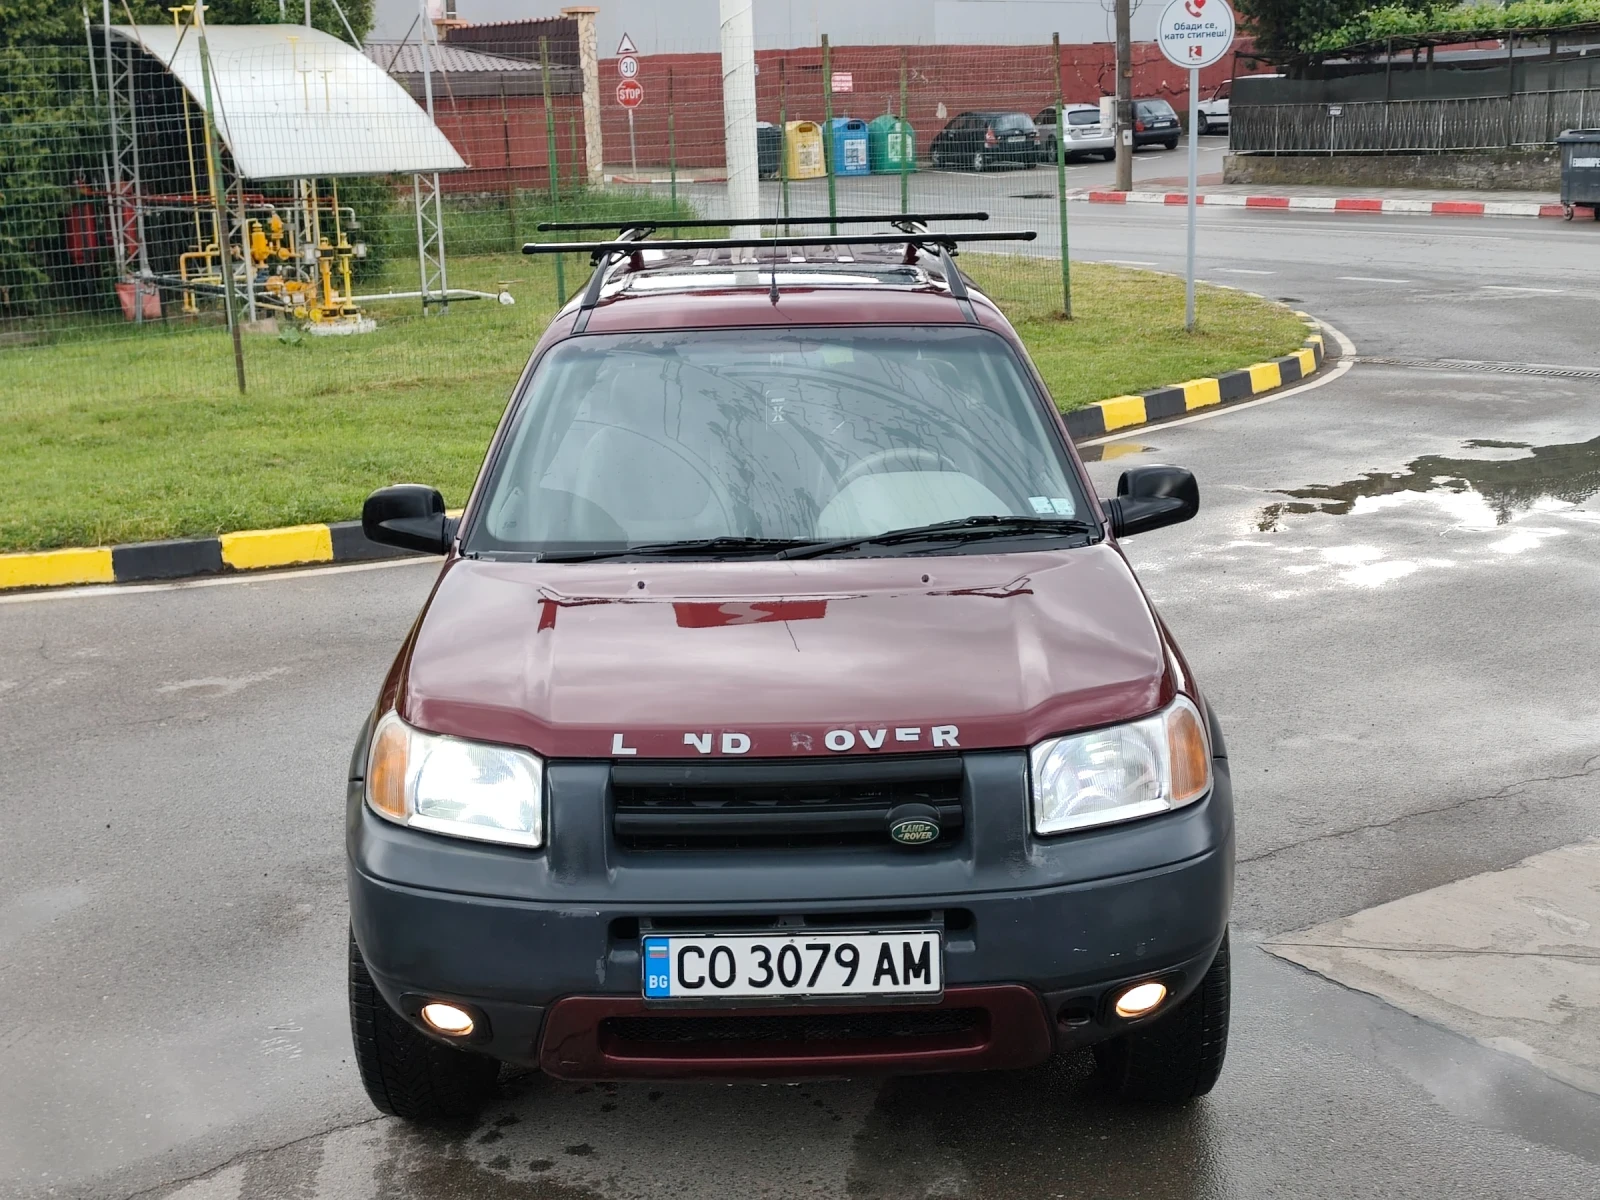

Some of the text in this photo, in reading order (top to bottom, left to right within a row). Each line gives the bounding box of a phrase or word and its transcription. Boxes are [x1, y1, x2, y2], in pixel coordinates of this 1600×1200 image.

[1173, 22, 1218, 31] Обади се,
[1187, 29, 1227, 39] стигнеш!
[622, 61, 635, 73] 30
[619, 88, 641, 100] STOP
[901, 824, 925, 833] LAND
[903, 831, 933, 840] ROVER
[677, 940, 932, 989] CO 3079 AM
[648, 974, 669, 989] BG
